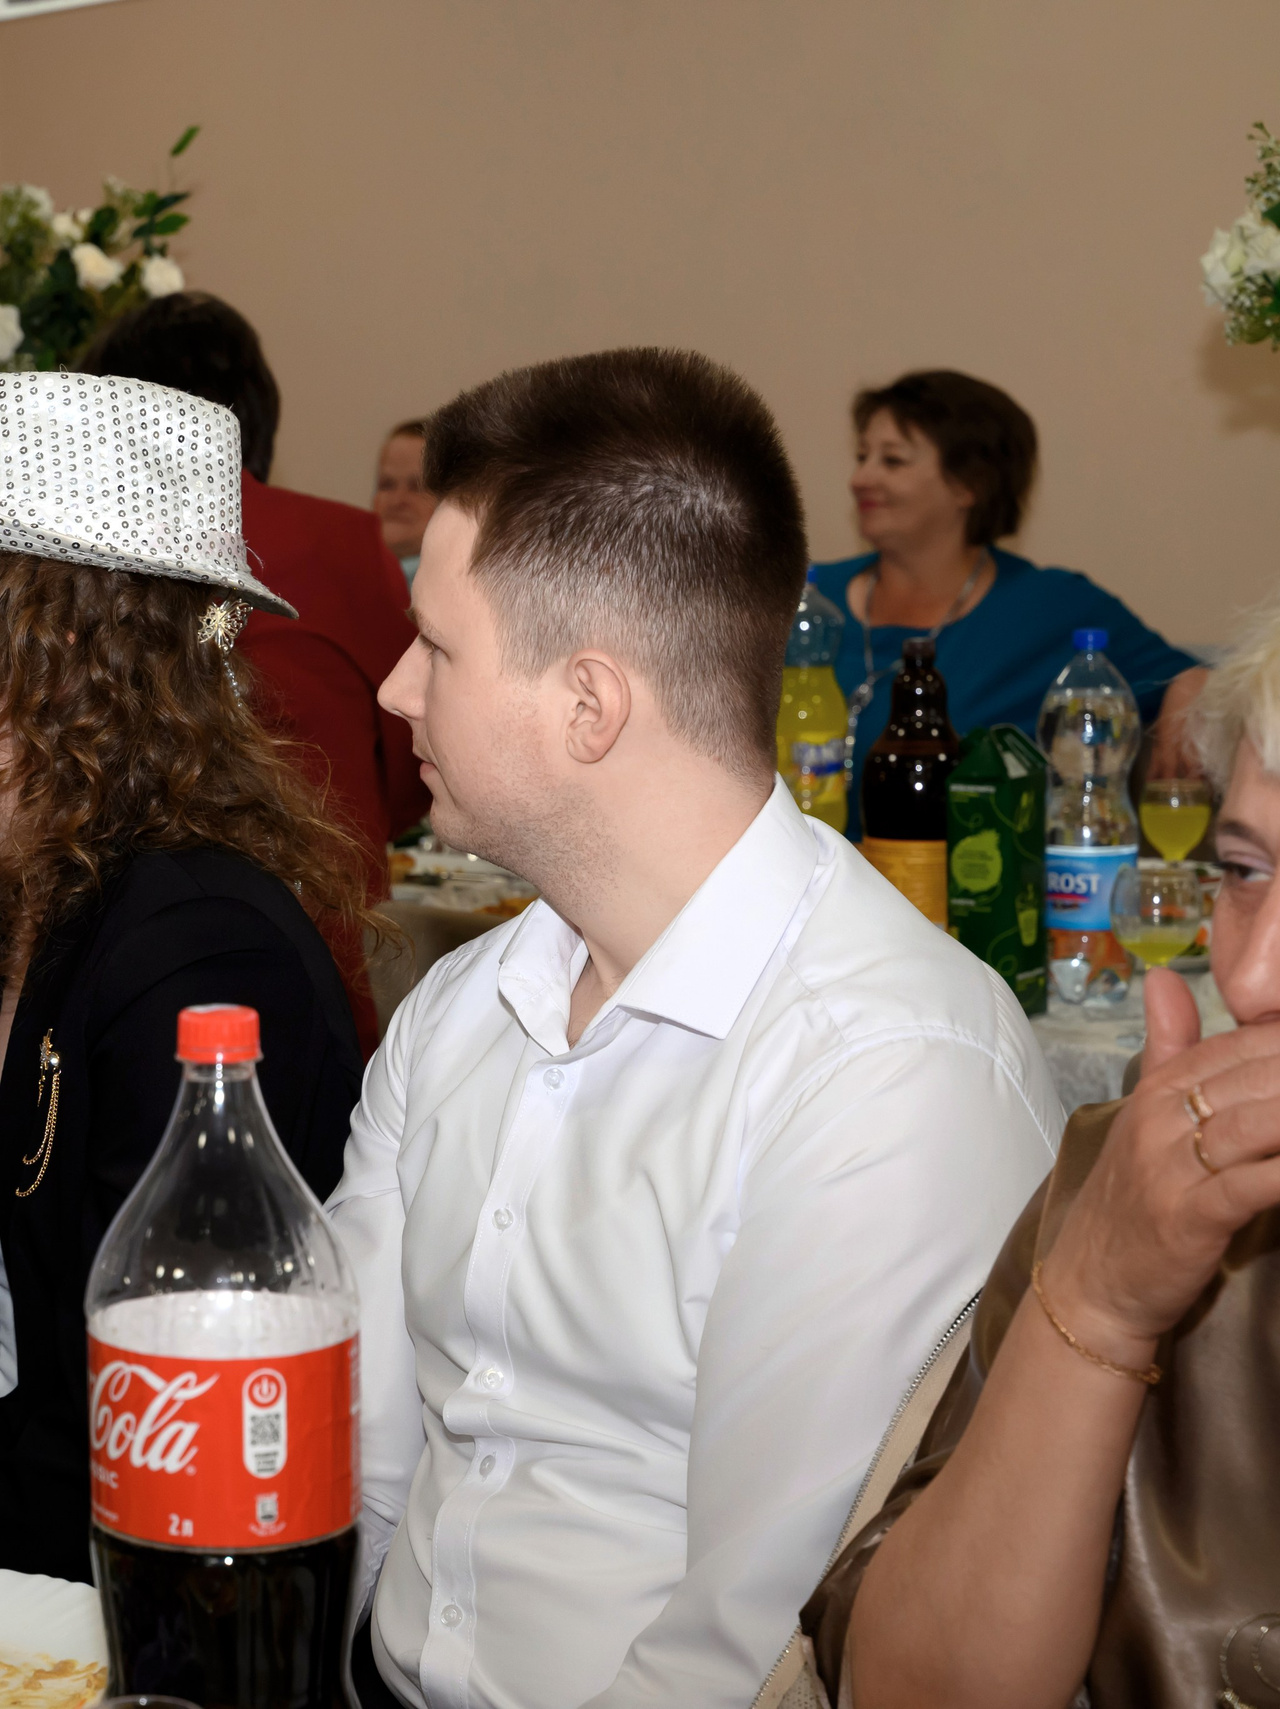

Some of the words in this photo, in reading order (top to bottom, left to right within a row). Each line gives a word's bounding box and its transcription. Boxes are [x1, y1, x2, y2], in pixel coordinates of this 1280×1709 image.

[1047, 871, 1101, 895] ROST
[90, 1360, 220, 1474] Cola
[168, 1513, 179, 1536] 2
